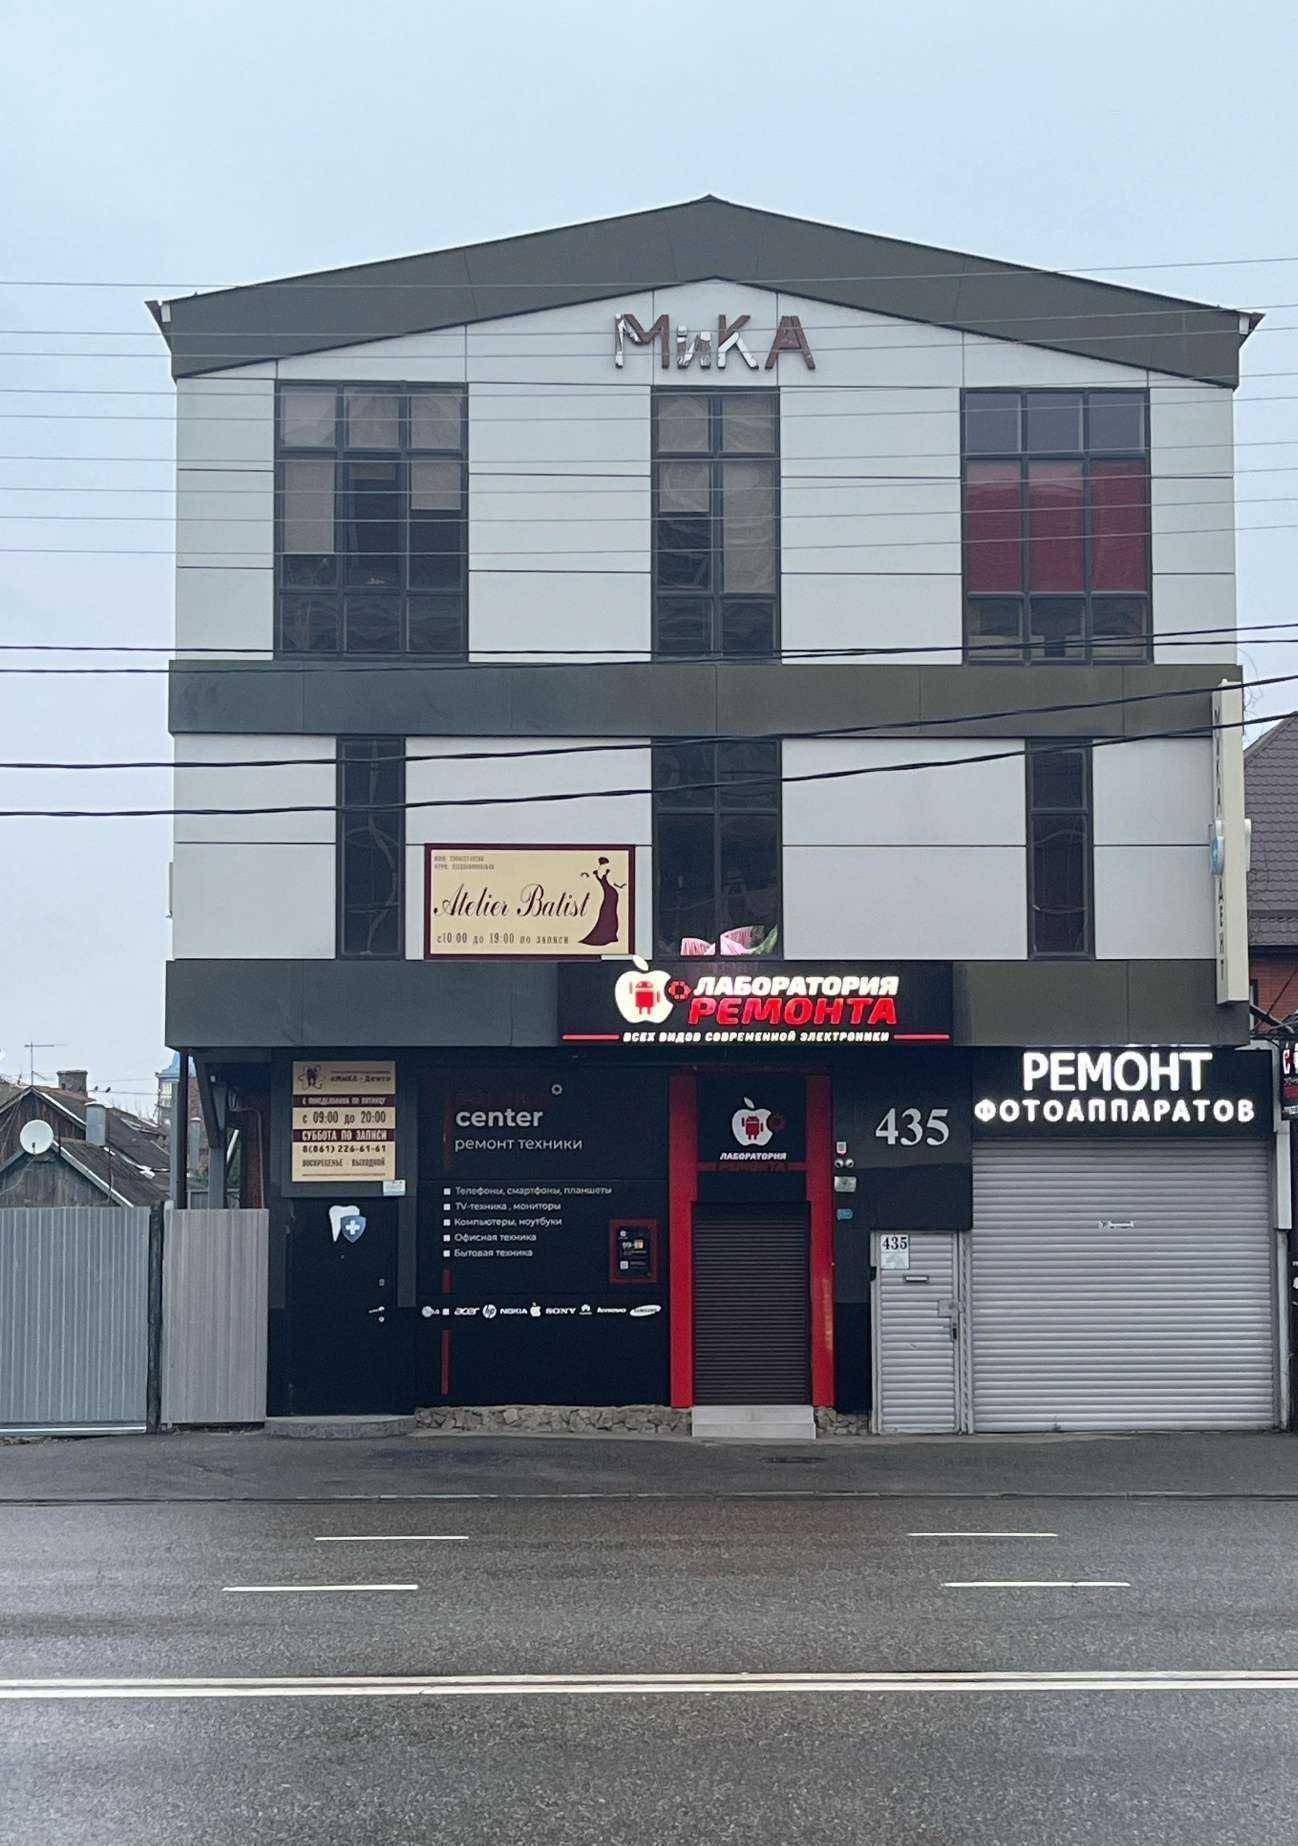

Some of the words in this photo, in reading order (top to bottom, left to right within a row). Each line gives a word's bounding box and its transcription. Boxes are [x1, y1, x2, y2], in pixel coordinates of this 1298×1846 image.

[433, 883, 510, 917] Atelier
[517, 883, 591, 917] Batist
[473, 935, 484, 945] до
[490, 932, 515, 944] 19:00
[519, 935, 531, 944] по
[536, 935, 569, 944] записи
[692, 976, 900, 996] ЛАБОРАТОРИЯ
[687, 997, 897, 1025] РЕМОНТА
[622, 1031, 656, 1042] ВСЕХ
[659, 1031, 701, 1043] ВИДОВ
[705, 1030, 797, 1042] СОВРЕМЕННОЙ
[800, 1031, 890, 1042] ЭЛЕКТРОНИКИ
[1022, 1052, 1214, 1091] РЕМОНТ
[313, 1111, 339, 1124] 09:00
[344, 1114, 355, 1125] до
[360, 1110, 386, 1123] 20:00
[974, 1099, 1256, 1123] ФОТОАППАРАТОВ
[455, 1108, 544, 1128] center
[875, 1107, 950, 1146] 435
[302, 1130, 337, 1141] СУББОТА
[341, 1130, 352, 1141] ПО
[356, 1130, 387, 1141] ЗАПИСИ
[455, 1138, 515, 1153] ремонт
[518, 1138, 583, 1150] техники
[720, 1152, 787, 1160] ЛАБОРАТОРИЯ
[455, 1186, 506, 1196] Телефоны,
[506, 1186, 563, 1196] смартфоны,
[564, 1186, 612, 1195] планшеты
[455, 1202, 507, 1210] TV-техника
[513, 1203, 562, 1212] мониторы
[454, 1218, 517, 1228] Компьютеры,
[518, 1216, 562, 1228] ноутбуки
[454, 1233, 498, 1243] Офисная
[499, 1234, 537, 1242] техника
[882, 1236, 908, 1250] 435
[454, 1248, 494, 1257] Бытовая
[495, 1249, 533, 1257] техника
[545, 1307, 577, 1315] SONY
